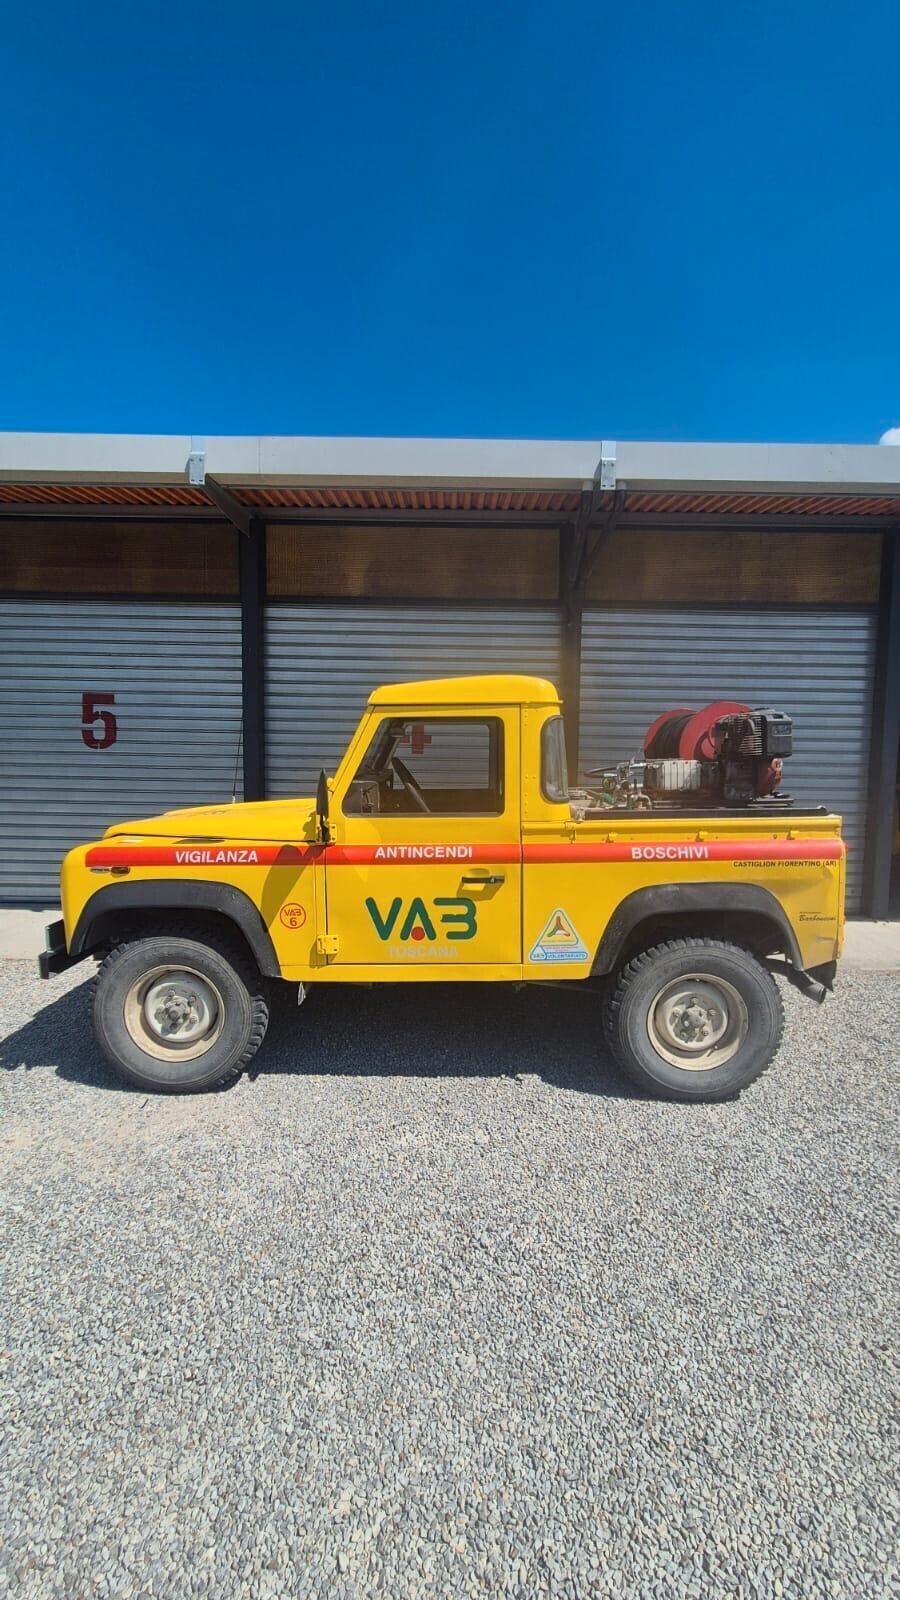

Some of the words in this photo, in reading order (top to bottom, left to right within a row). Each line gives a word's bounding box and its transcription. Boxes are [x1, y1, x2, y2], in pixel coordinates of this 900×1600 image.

[81, 693, 117, 750] 5
[175, 850, 258, 864] VIGILANZA
[375, 846, 473, 859] ANTINCENDI
[631, 846, 709, 860] BOSCHIVI
[733, 860, 776, 868] CASTIGLION
[777, 860, 821, 868] FIORENTINO
[822, 860, 837, 869] (AR)
[289, 917, 298, 927] 6
[365, 896, 478, 942] VAB
